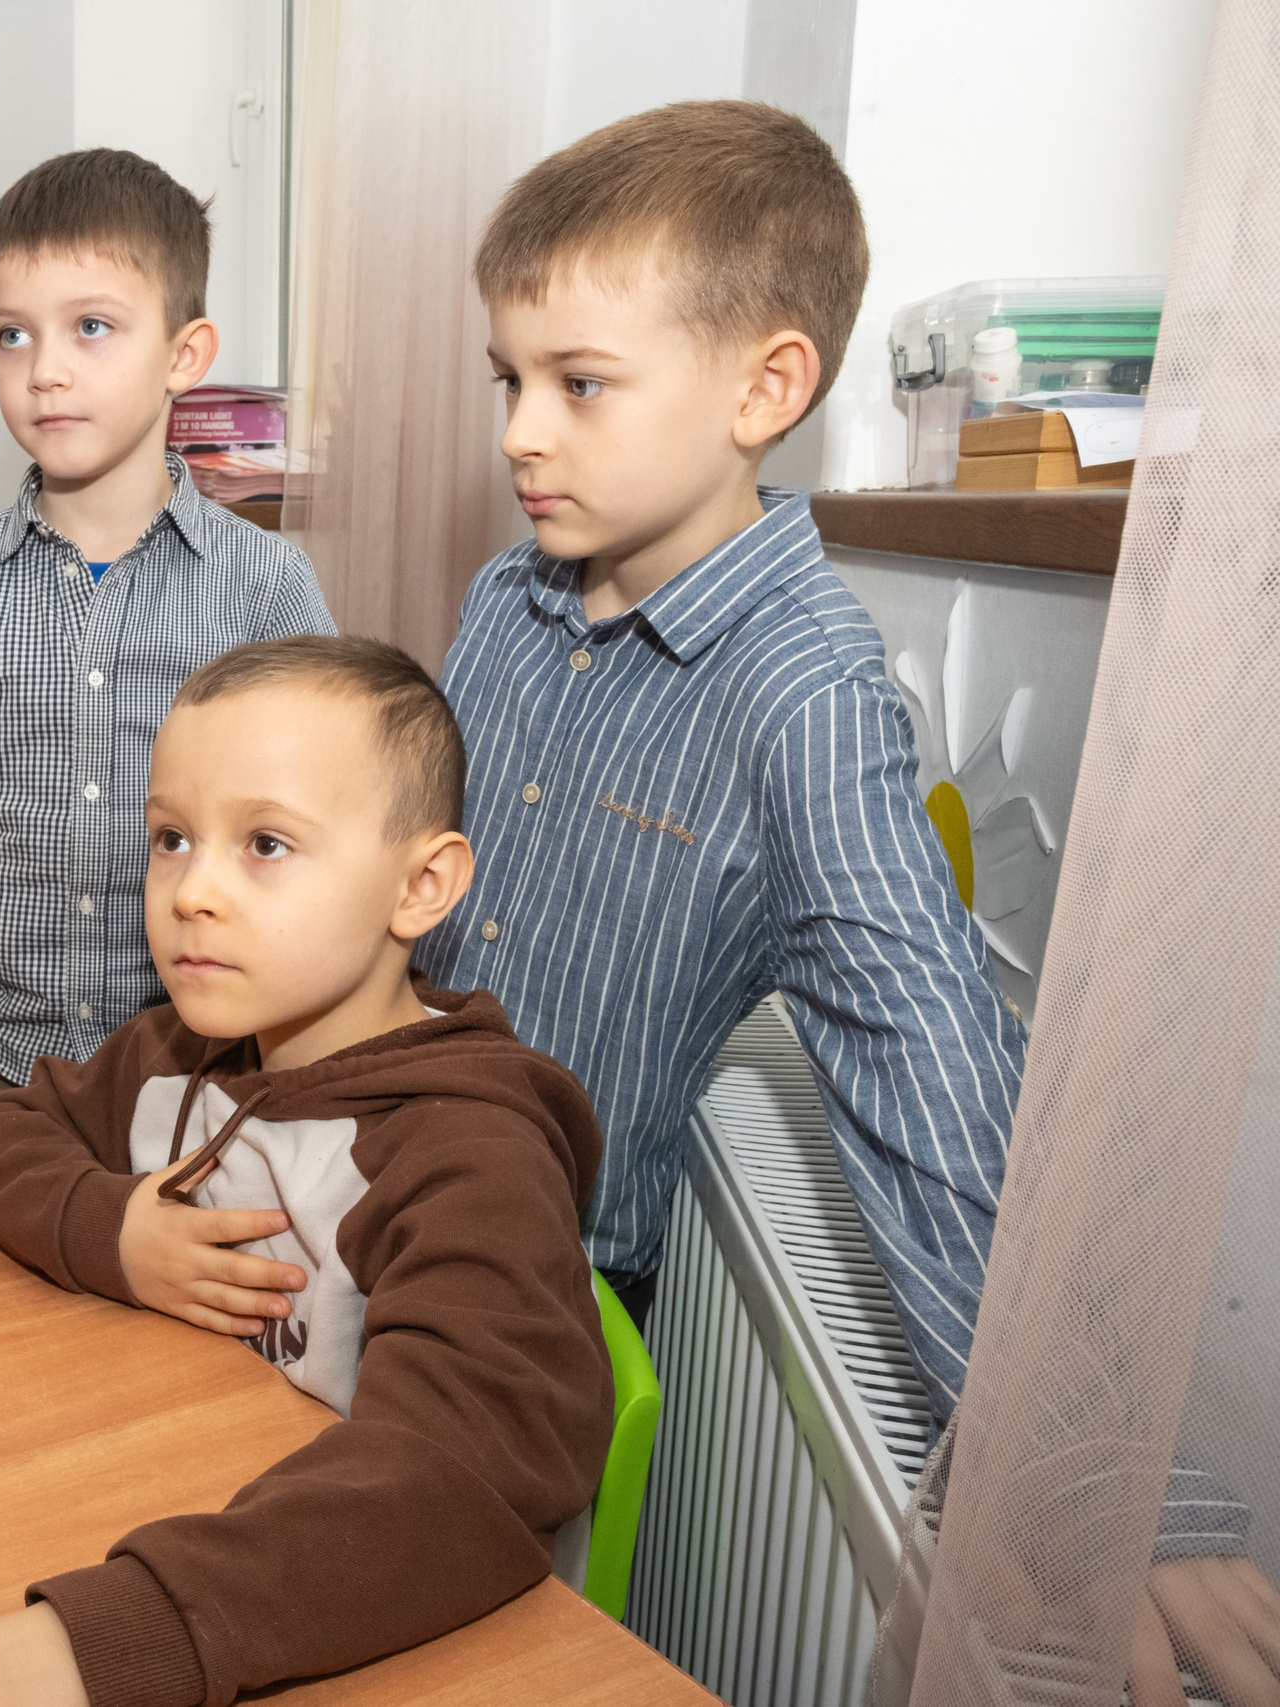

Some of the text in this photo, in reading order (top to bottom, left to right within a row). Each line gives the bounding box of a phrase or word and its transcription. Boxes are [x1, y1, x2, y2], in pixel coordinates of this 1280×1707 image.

[173, 411, 233, 421] CURTAIN LIGHT
[173, 421, 235, 430] 3 M 10 HANGING
